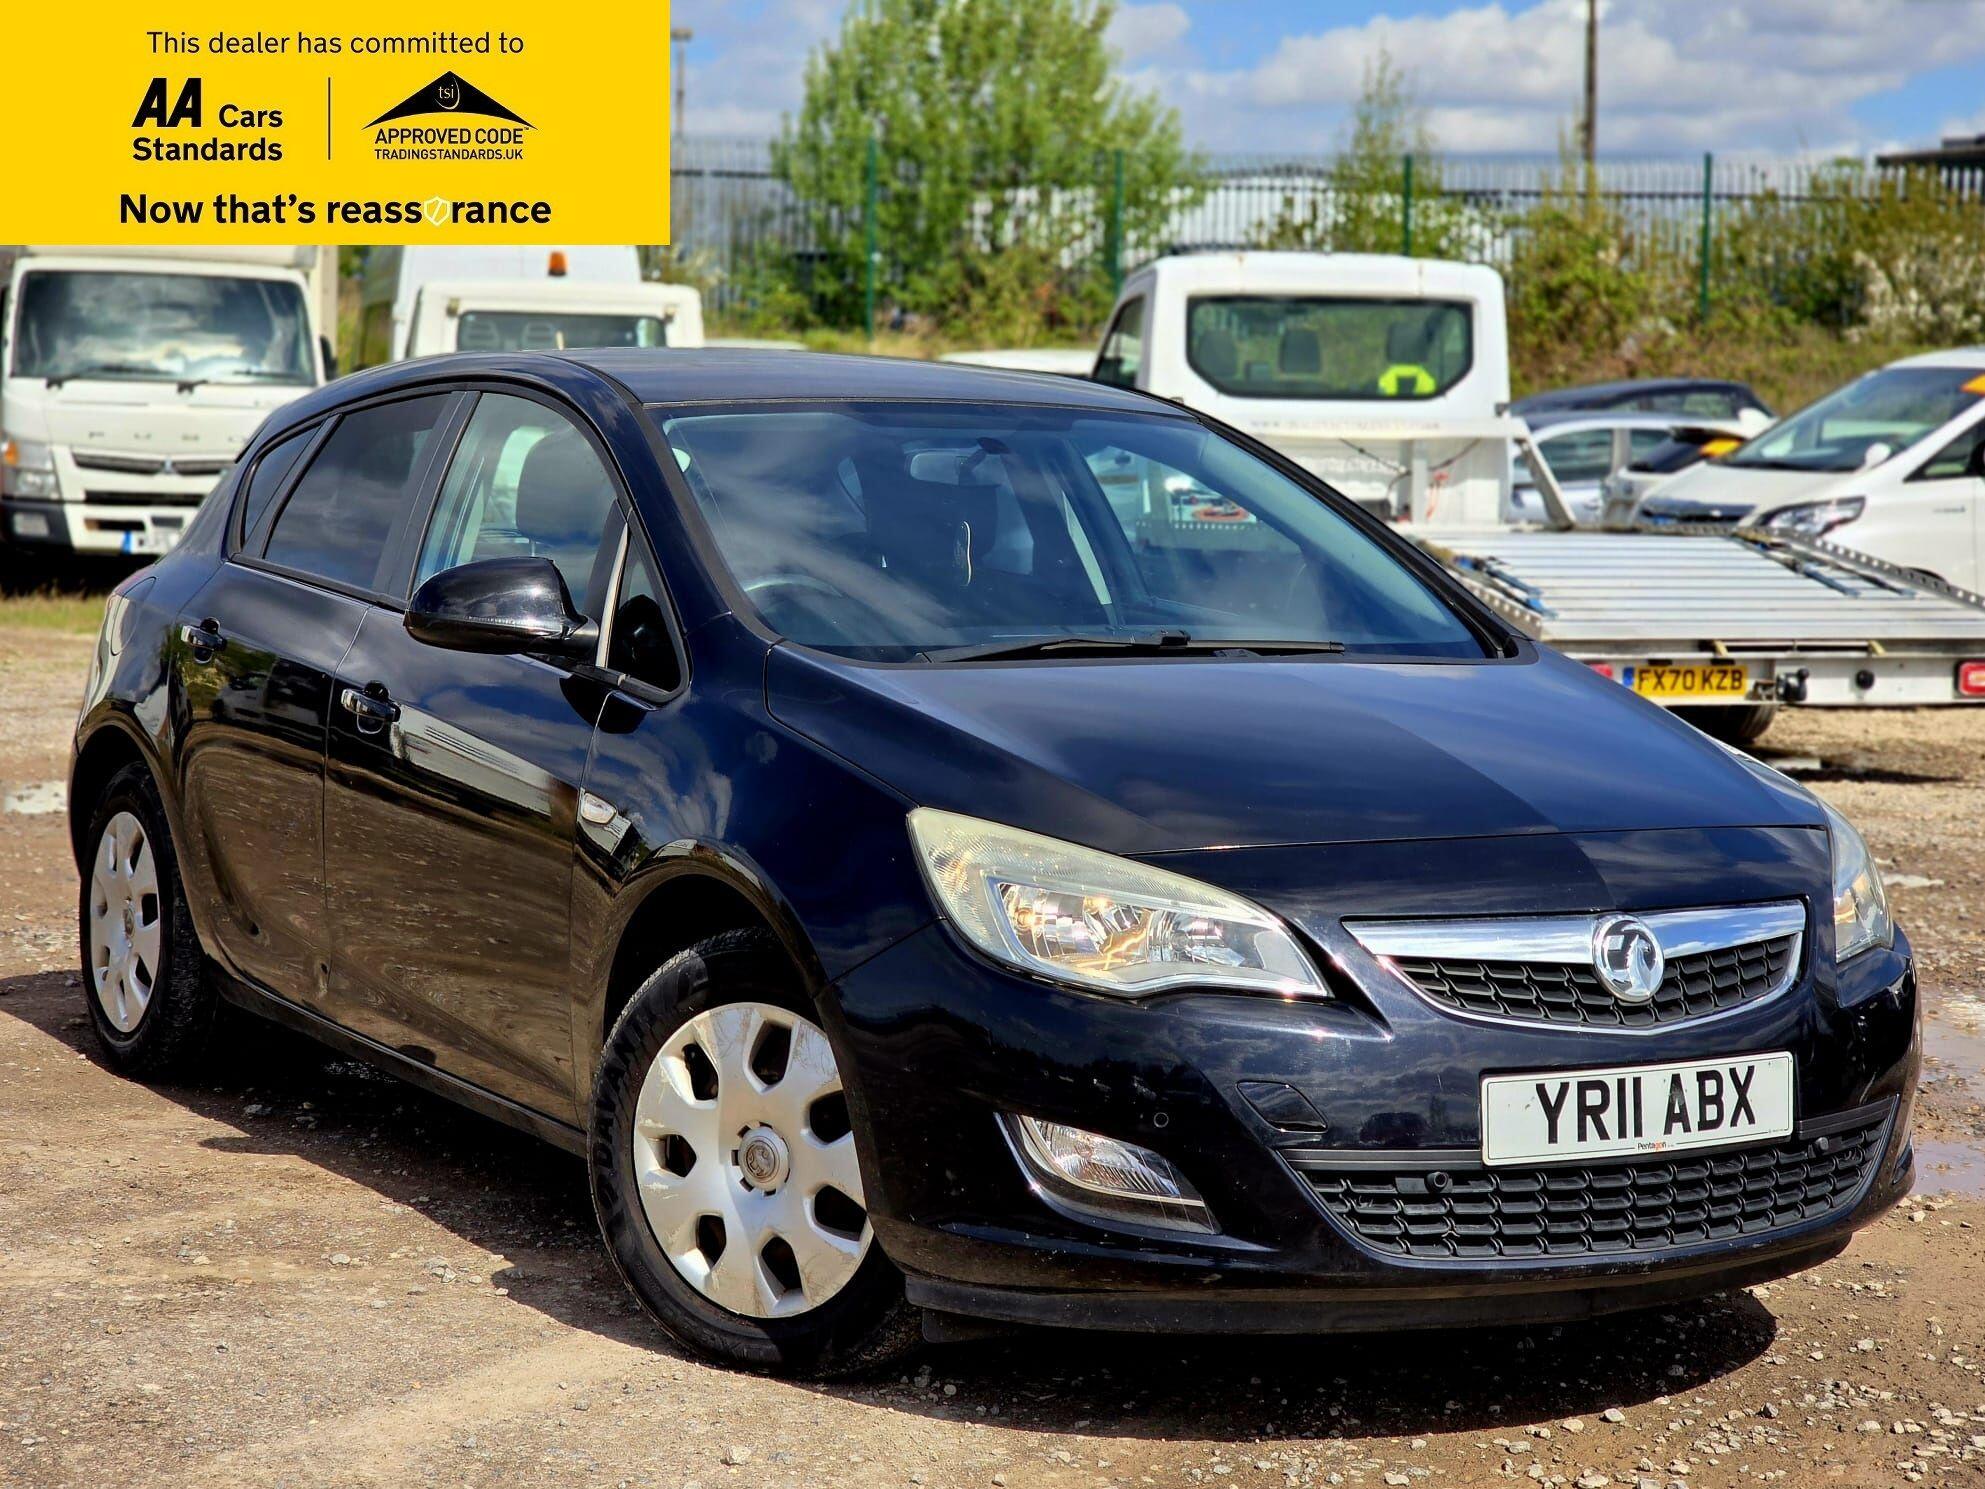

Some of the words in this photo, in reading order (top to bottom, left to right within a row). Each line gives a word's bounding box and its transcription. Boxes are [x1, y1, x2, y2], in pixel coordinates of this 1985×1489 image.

[1638, 669, 1696, 691] FX70
[1701, 669, 1743, 691] KZB
[1535, 1076, 1643, 1145] YR11
[1663, 1065, 1756, 1135] ABX
[1637, 1141, 1667, 1151] Pentagon
